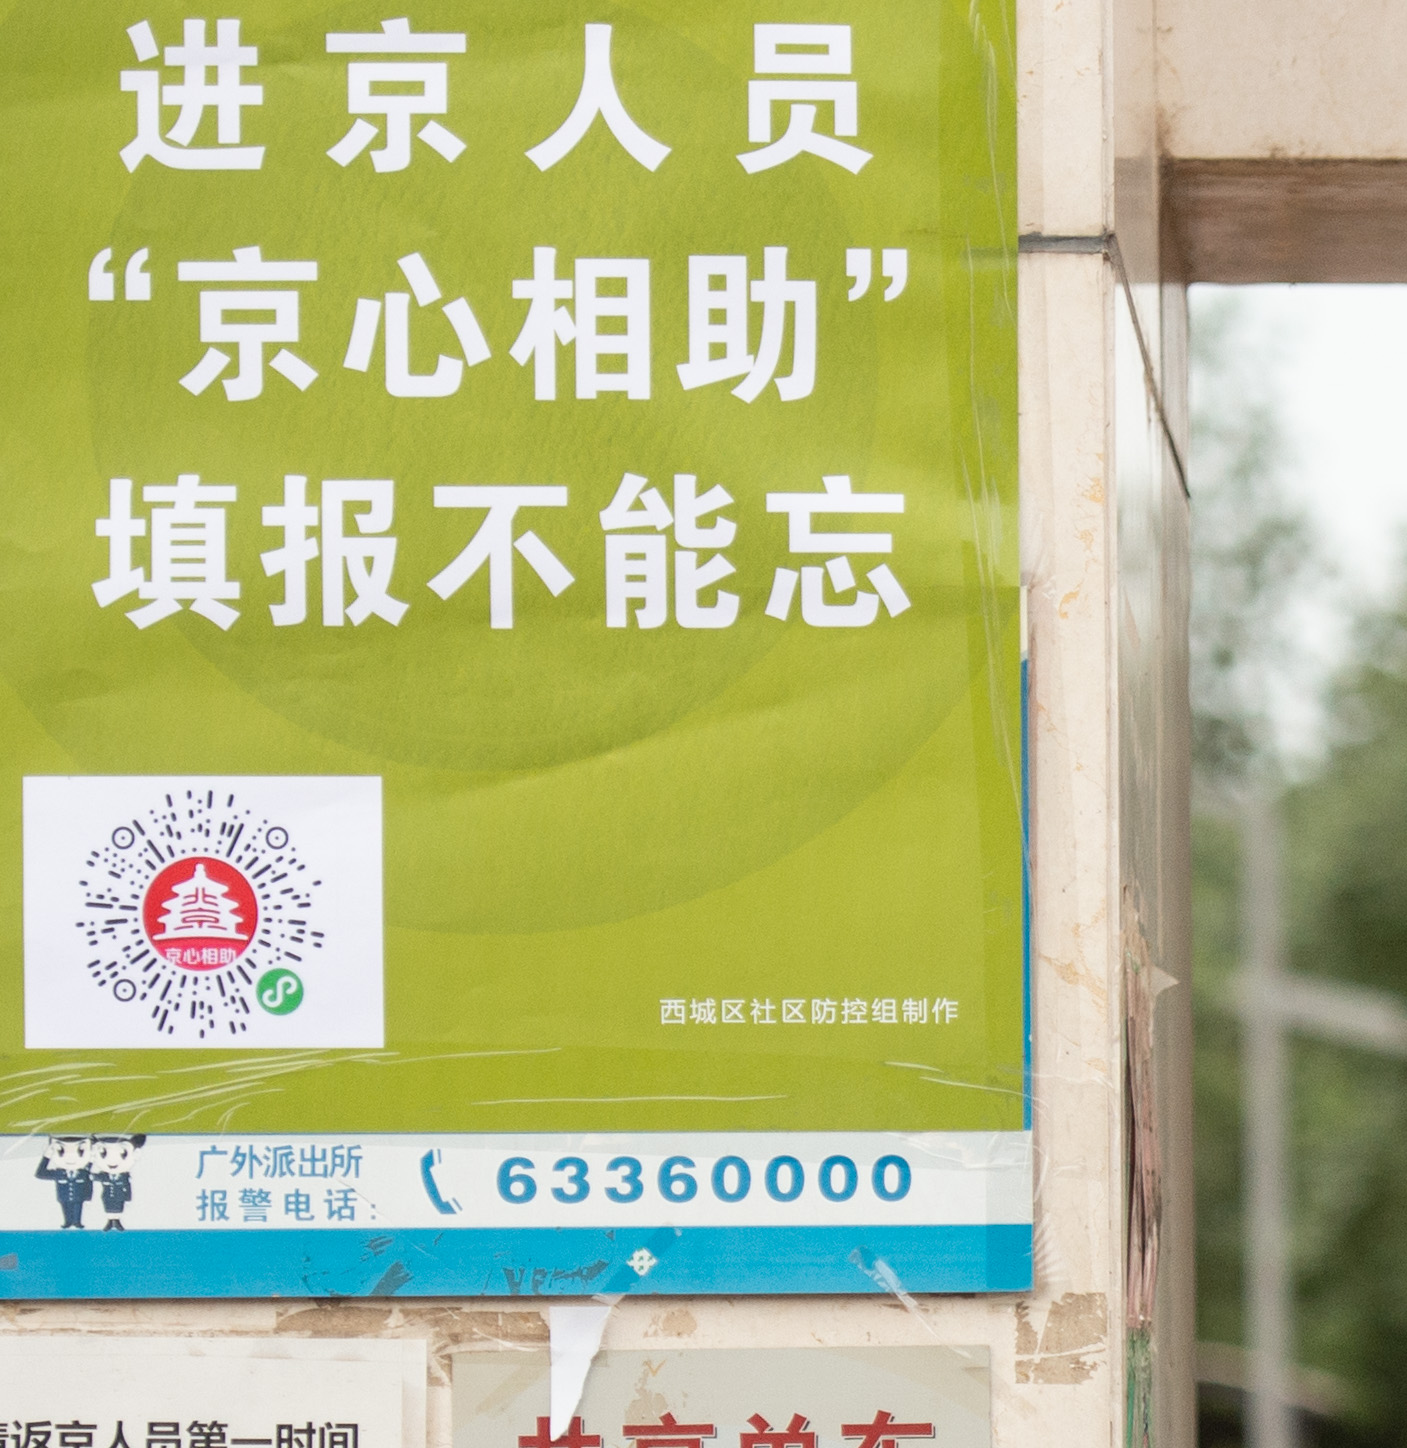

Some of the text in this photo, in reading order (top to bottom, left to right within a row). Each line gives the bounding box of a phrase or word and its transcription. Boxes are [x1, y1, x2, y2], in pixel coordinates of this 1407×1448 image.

[119, 17, 874, 176] 进京人员
[88, 245, 908, 404] “京心相助”
[91, 472, 912, 631] 填报不能忘
[164, 947, 238, 965] 京心相助
[659, 997, 959, 1026] 西城区社区防控组制作
[195, 1144, 364, 1181] 广外派出所
[496, 1154, 912, 1205] 63360000
